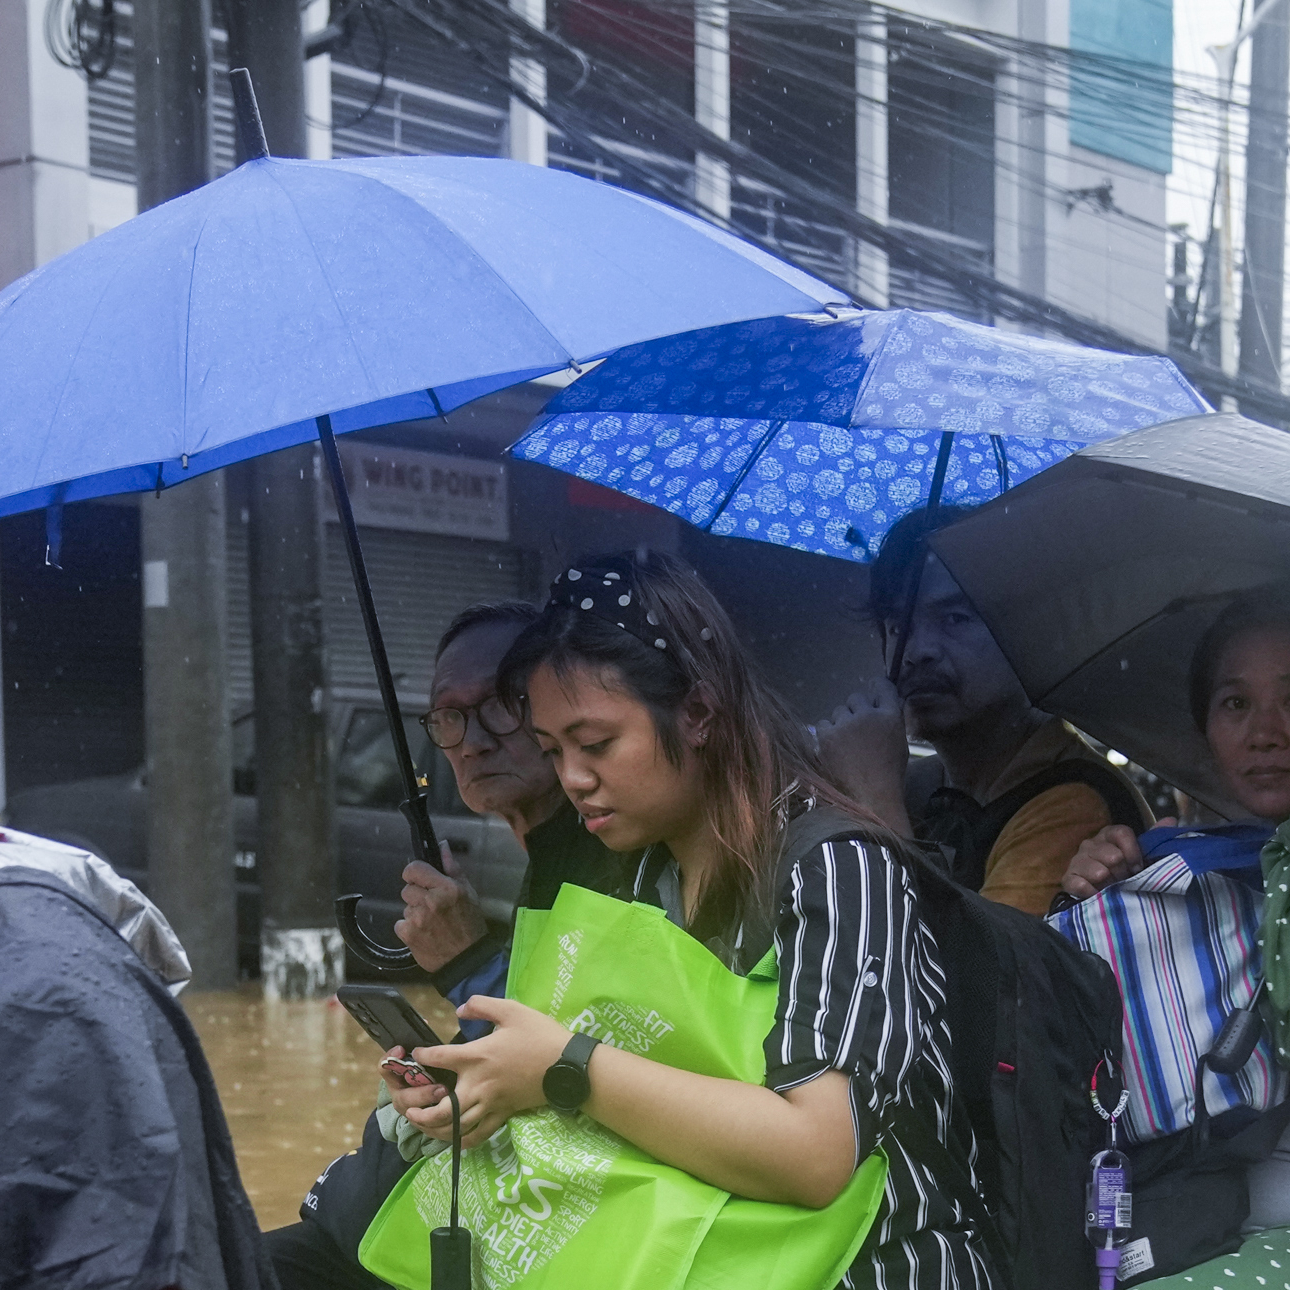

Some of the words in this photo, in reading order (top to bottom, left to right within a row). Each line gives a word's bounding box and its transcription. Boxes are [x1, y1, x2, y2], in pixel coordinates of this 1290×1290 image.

[428, 467, 499, 502] POINT
[559, 933, 578, 955] RUN
[558, 967, 574, 983] FIT
[604, 1003, 655, 1052] FITNESS
[644, 1009, 674, 1038] FIT
[522, 1121, 565, 1158] FITNESS
[553, 1158, 574, 1176] RUN
[574, 1150, 614, 1172] DIET
[570, 1172, 604, 1195] LIVING
[563, 1191, 598, 1216] ENERGY
[500, 1207, 544, 1244] DIET
[544, 1226, 568, 1246] ACTIVE
[552, 1214, 580, 1236] ACTIVITY
[472, 1204, 538, 1274] HEALTH
